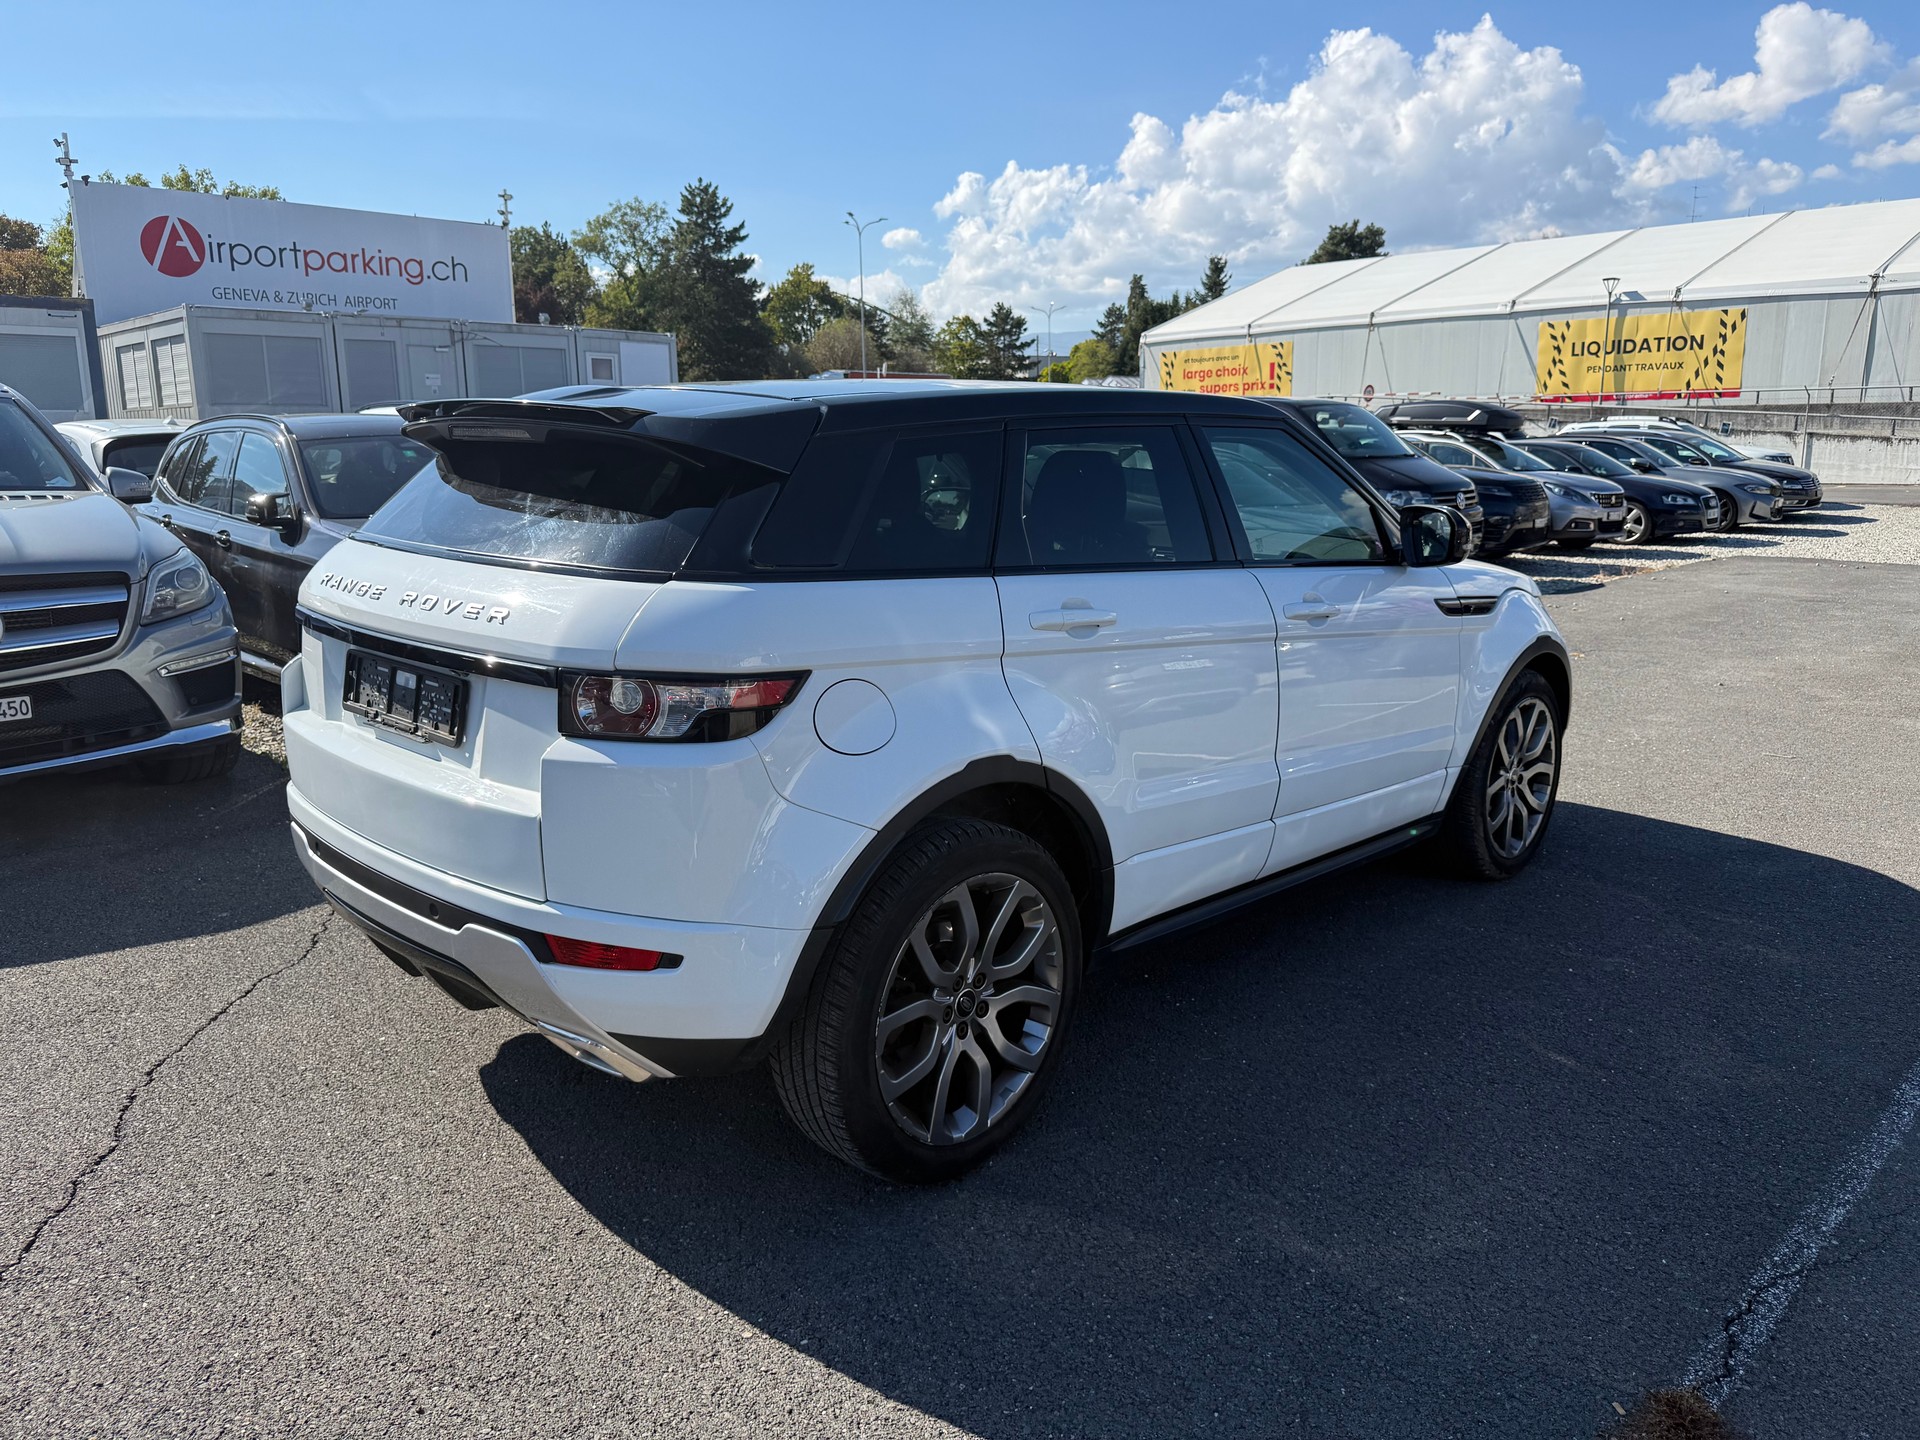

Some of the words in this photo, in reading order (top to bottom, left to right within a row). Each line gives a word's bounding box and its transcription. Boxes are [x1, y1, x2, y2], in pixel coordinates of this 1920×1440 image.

[212, 287, 271, 303] GENEVA
[273, 290, 284, 304] &
[287, 291, 338, 306] ZURICH
[344, 296, 398, 311] AIRPORT
[1571, 334, 1705, 358] LIQUIDATION
[1191, 355, 1215, 364] toujours
[1587, 363, 1633, 374] PENDANT
[1635, 361, 1685, 372] TRAVAUX
[1183, 368, 1213, 382] large
[1215, 364, 1248, 377] choix
[1200, 383, 1239, 395] supers
[1242, 379, 1267, 396] prix
[320, 572, 387, 600] RANGE
[399, 591, 511, 625] ROVER
